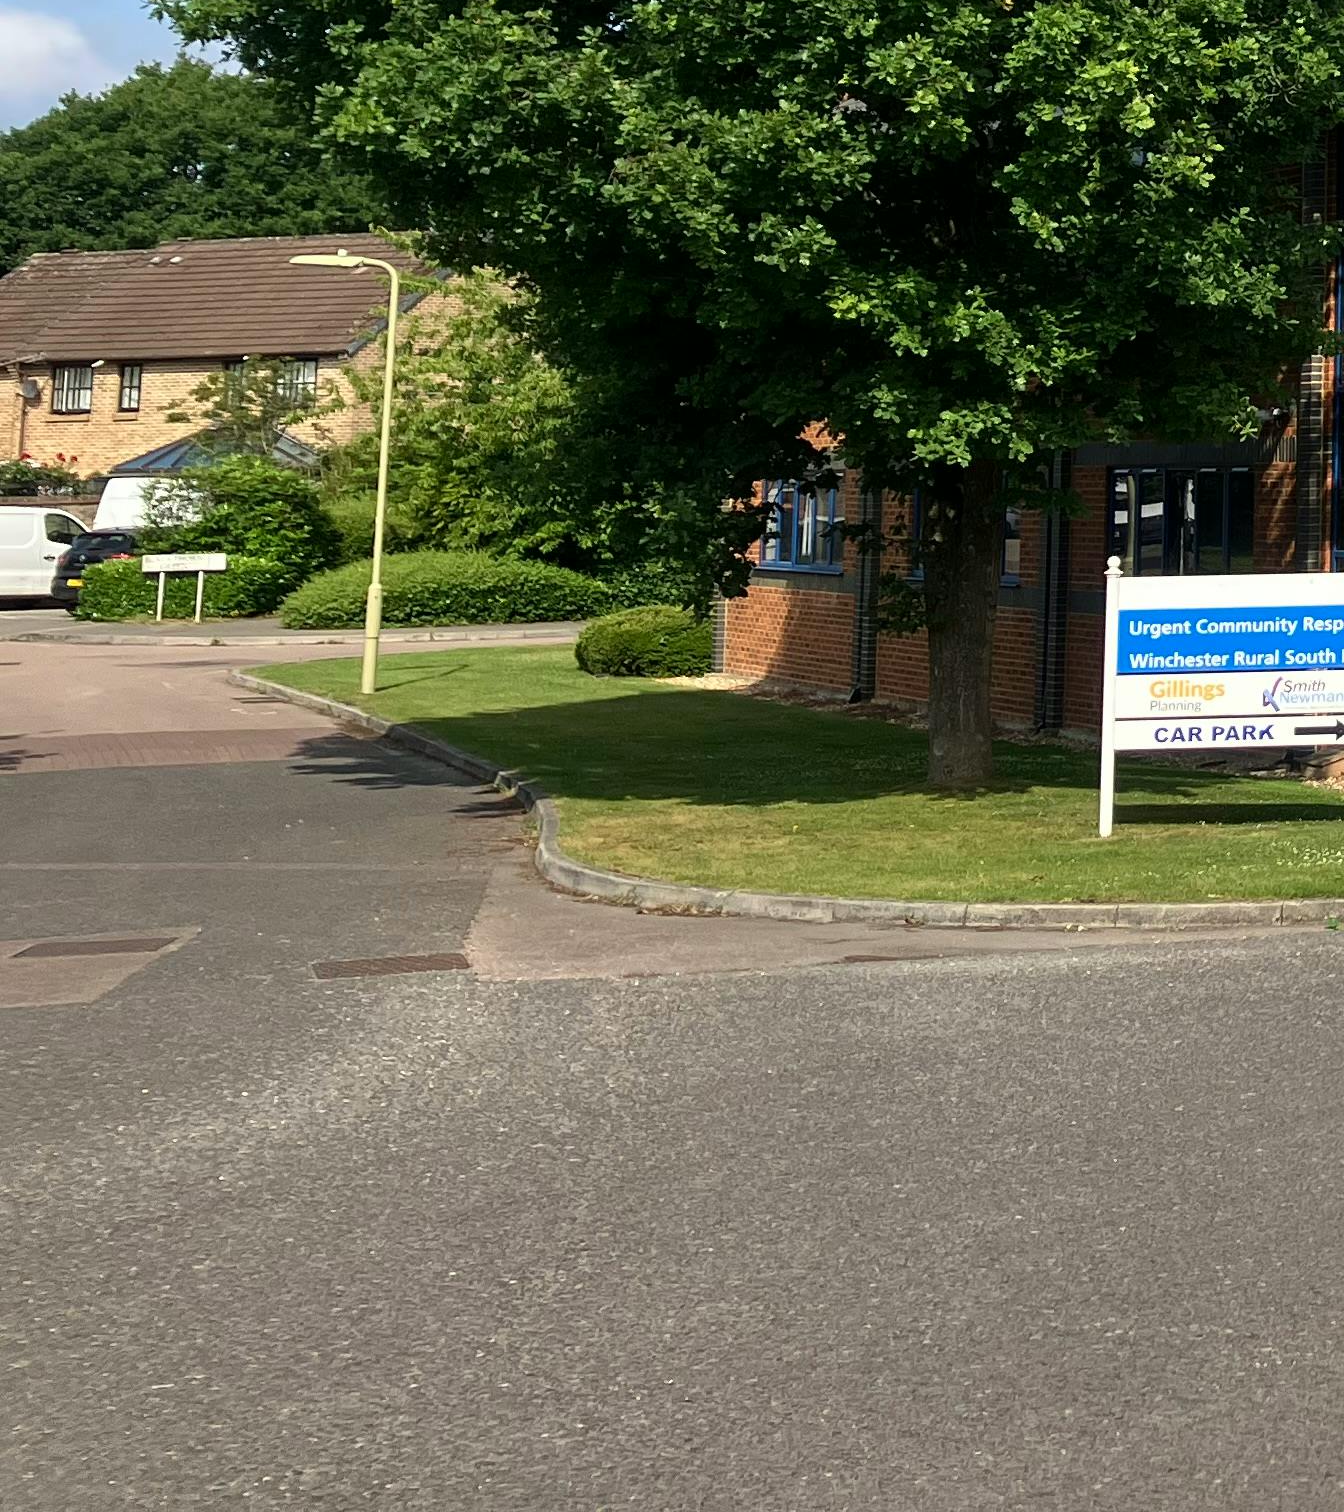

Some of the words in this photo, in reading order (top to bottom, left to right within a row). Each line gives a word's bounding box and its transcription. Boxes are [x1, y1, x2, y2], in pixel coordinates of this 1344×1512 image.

[1129, 620, 1191, 639] Urgent
[1196, 617, 1298, 636] Community
[1129, 652, 1229, 669] Winchester
[1234, 650, 1279, 666] Rural
[1285, 648, 1336, 665] South
[1149, 680, 1225, 700] Gillings
[1283, 679, 1326, 693] Smith
[1149, 700, 1202, 713] Planning
[1154, 726, 1203, 743] CAR
[1212, 724, 1275, 741] PARK
